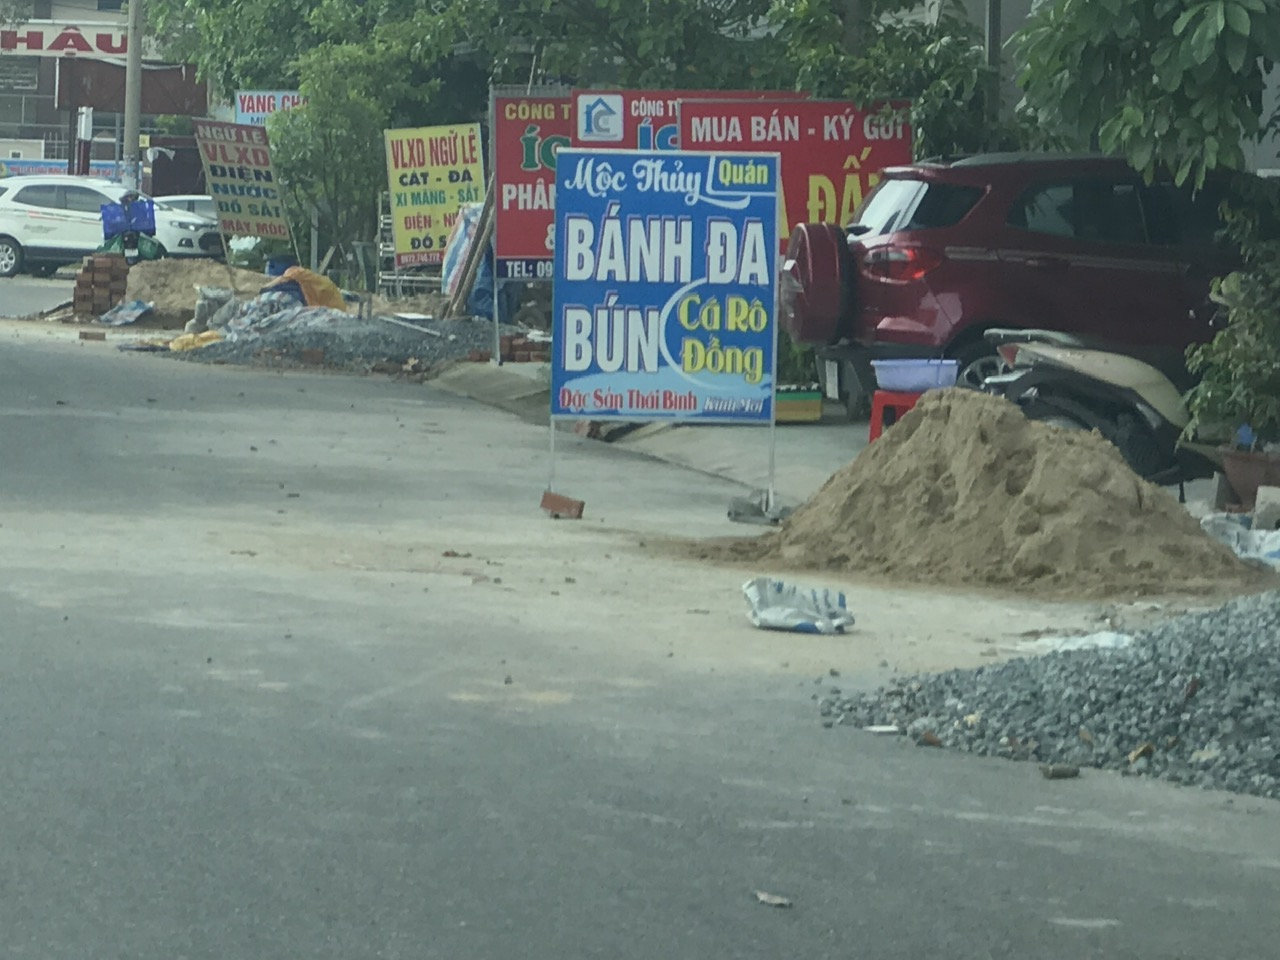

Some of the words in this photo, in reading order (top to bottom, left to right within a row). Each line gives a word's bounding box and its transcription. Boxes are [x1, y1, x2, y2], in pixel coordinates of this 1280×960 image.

[239, 95, 276, 113] YANG
[505, 100, 556, 121] CÔNG
[631, 97, 664, 117] CÔNG
[691, 116, 743, 142] MUA
[751, 109, 800, 141] BÁN
[824, 108, 855, 140] KÝ
[203, 142, 270, 167] VLXD
[391, 138, 426, 169] VLXD
[462, 128, 477, 164] LÊ
[399, 170, 429, 187] CÁT
[565, 157, 628, 198] Mộc
[632, 158, 703, 206] Thủy
[719, 159, 768, 186] Quán
[565, 200, 693, 283] BÁNH
[705, 214, 770, 285] ĐA
[506, 261, 533, 278] TEL:
[678, 293, 720, 331] Cá
[726, 293, 769, 332] Rô
[563, 290, 660, 373] BÚN
[681, 333, 764, 384] Đồng
[627, 388, 660, 410] Thái
